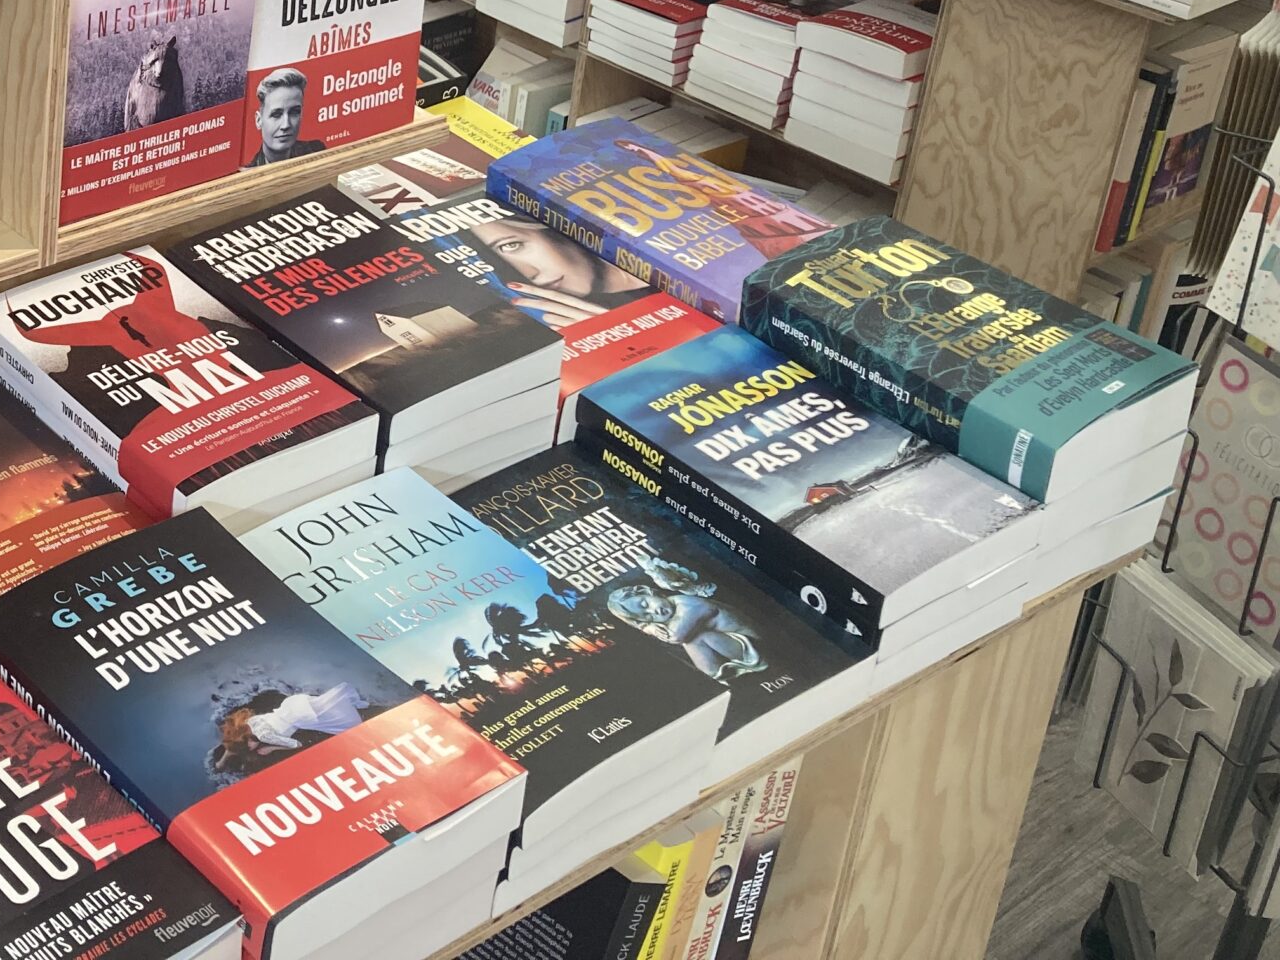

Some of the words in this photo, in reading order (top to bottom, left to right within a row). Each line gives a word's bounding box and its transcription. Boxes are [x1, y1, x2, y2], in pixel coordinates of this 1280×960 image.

[322, 59, 403, 96] Delzongle
[341, 84, 405, 118] sommet
[473, 79, 500, 101] VARG
[85, 143, 122, 167] MAÎTRE
[139, 129, 181, 153] THRILLER
[183, 116, 225, 141] POLONAIS
[543, 162, 614, 195] MICHEL
[565, 152, 753, 238] BUSSI
[192, 199, 339, 266] ARNALDUR
[673, 233, 747, 272] BABEL
[263, 289, 318, 317] DES
[318, 246, 425, 306] SILENCES
[785, 238, 952, 310] Turton
[87, 330, 240, 390] DÉLIVRE-NOUS
[576, 318, 636, 354] SUSPENSE
[160, 409, 212, 446] NOUVEAU
[210, 393, 264, 424] CHRYSTEL
[260, 375, 311, 406] DUCHAMP
[668, 360, 816, 435] JÓNASSON
[747, 391, 848, 438] ÂMES,
[796, 411, 871, 452] PLUS
[668, 466, 690, 487] plus
[543, 522, 650, 581] DORMIRA
[50, 552, 207, 630] GREBE
[73, 575, 236, 661] L'HORIZON
[354, 591, 455, 652] NELSON
[504, 700, 536, 726] grand
[533, 687, 606, 728] contemporain.
[516, 724, 564, 758] FOLLETT
[224, 718, 458, 857] NOUVEAUTÉ
[70, 880, 127, 921] MAÎTRE
[658, 859, 681, 919] LEMAITRE
